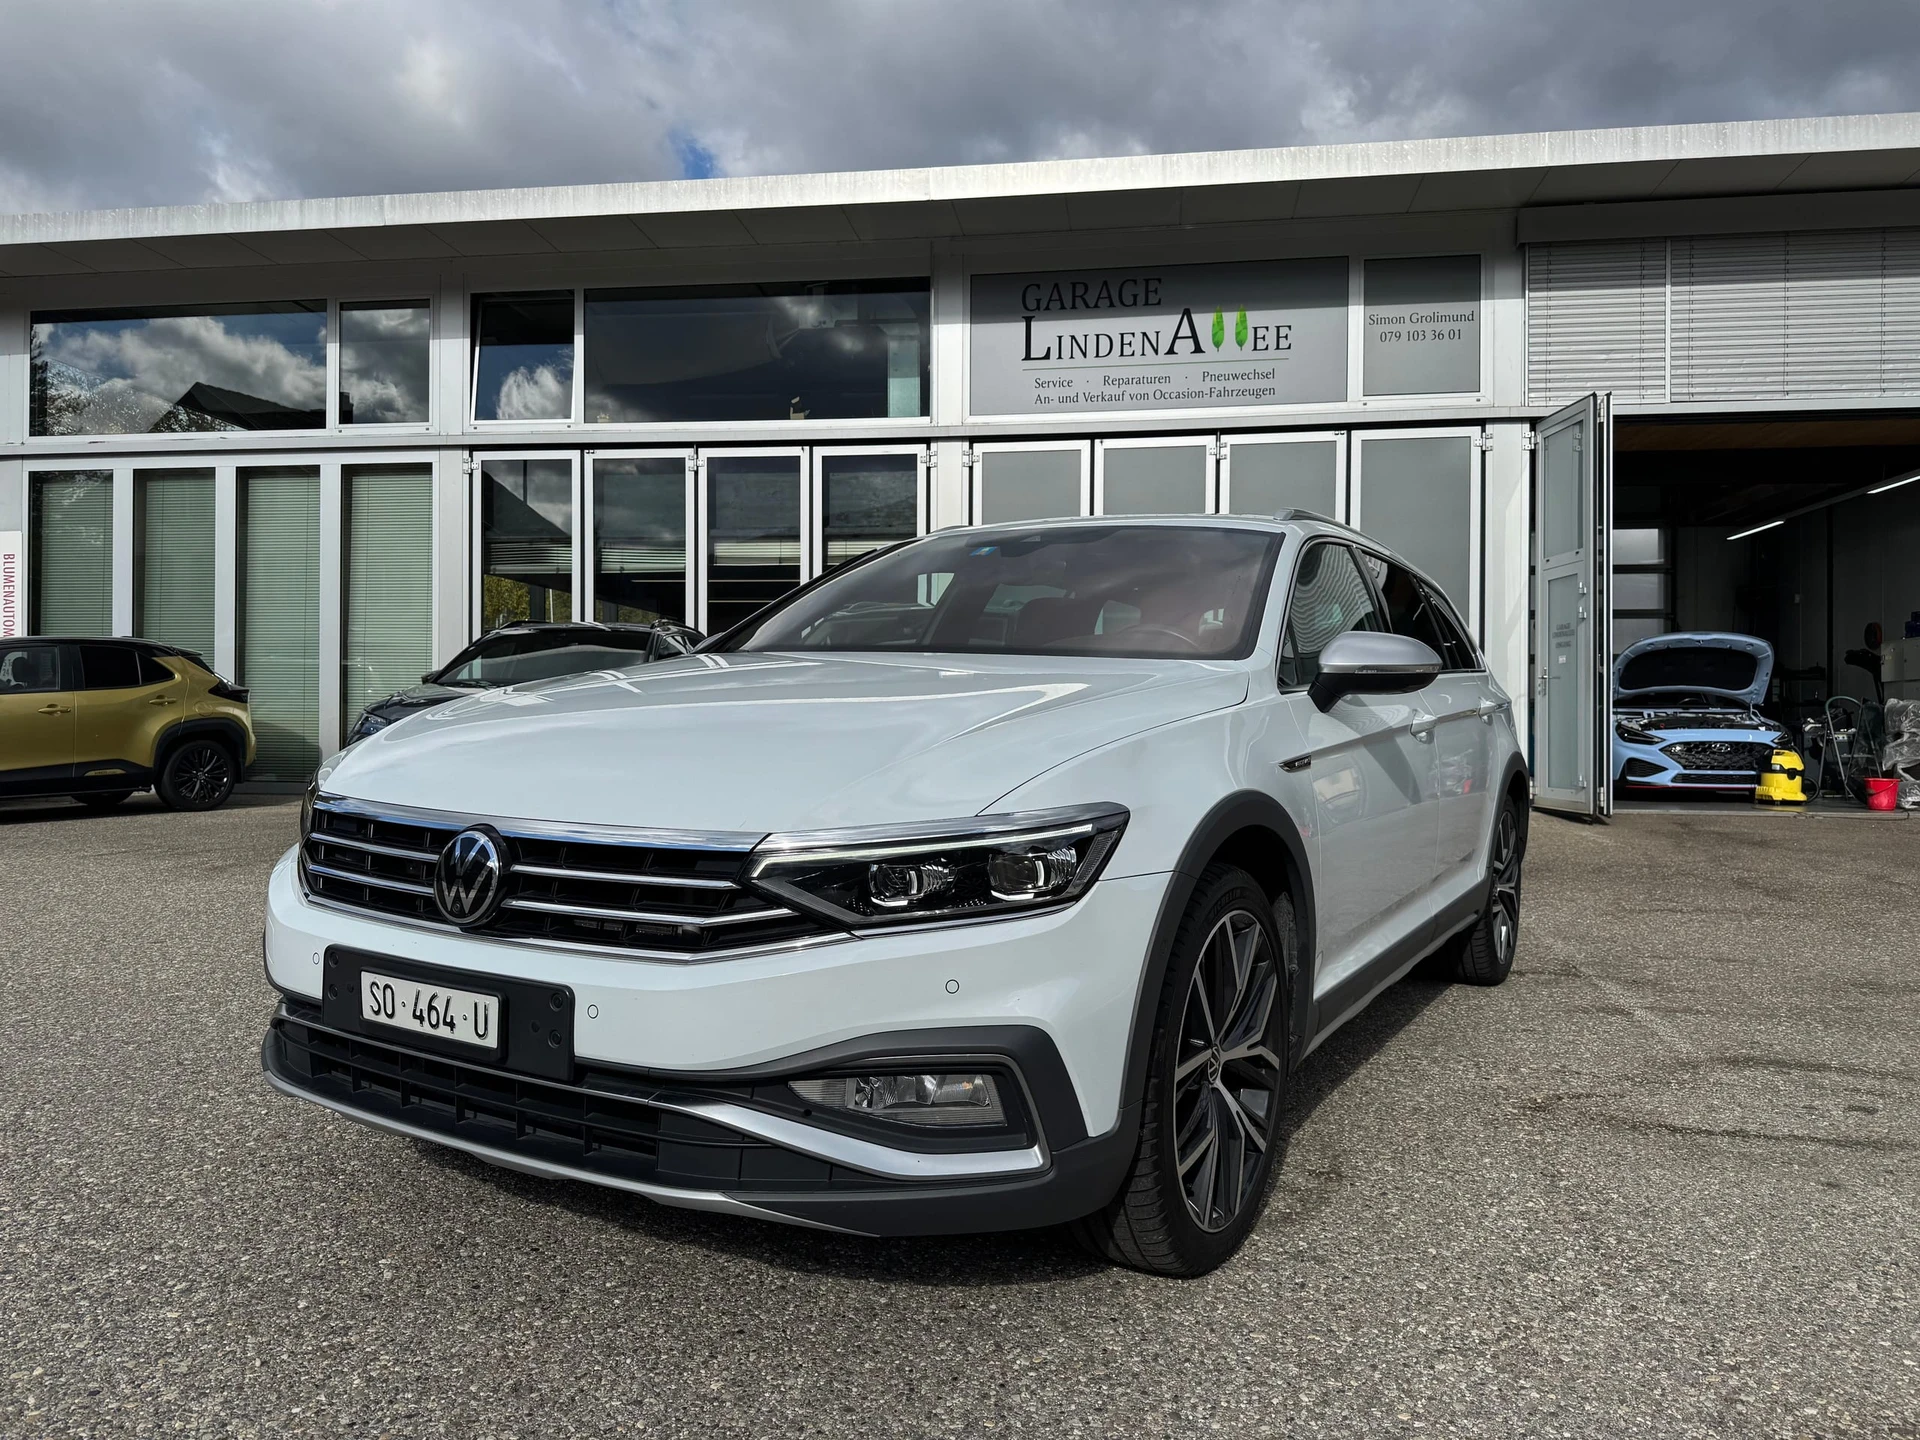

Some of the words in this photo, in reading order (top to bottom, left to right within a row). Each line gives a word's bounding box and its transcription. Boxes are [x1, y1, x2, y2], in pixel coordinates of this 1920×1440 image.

[1021, 278, 1162, 312] GARAGE
[1368, 313, 1406, 326] Simon
[1409, 310, 1475, 324] Grolimund
[1379, 331, 1401, 342] 079
[1406, 330, 1426, 342] 103
[1430, 329, 1445, 341] 36
[1448, 328, 1462, 340] 01
[1034, 376, 1073, 390] Service
[1103, 373, 1171, 388] Reparaturen
[1202, 368, 1275, 383] Pneuwechsel
[1034, 393, 1055, 405] An-
[1058, 391, 1079, 404] und
[1082, 389, 1126, 403] Verkauf
[1129, 391, 1150, 402] von
[1152, 385, 1276, 402] Occasion-Fahrzeugen
